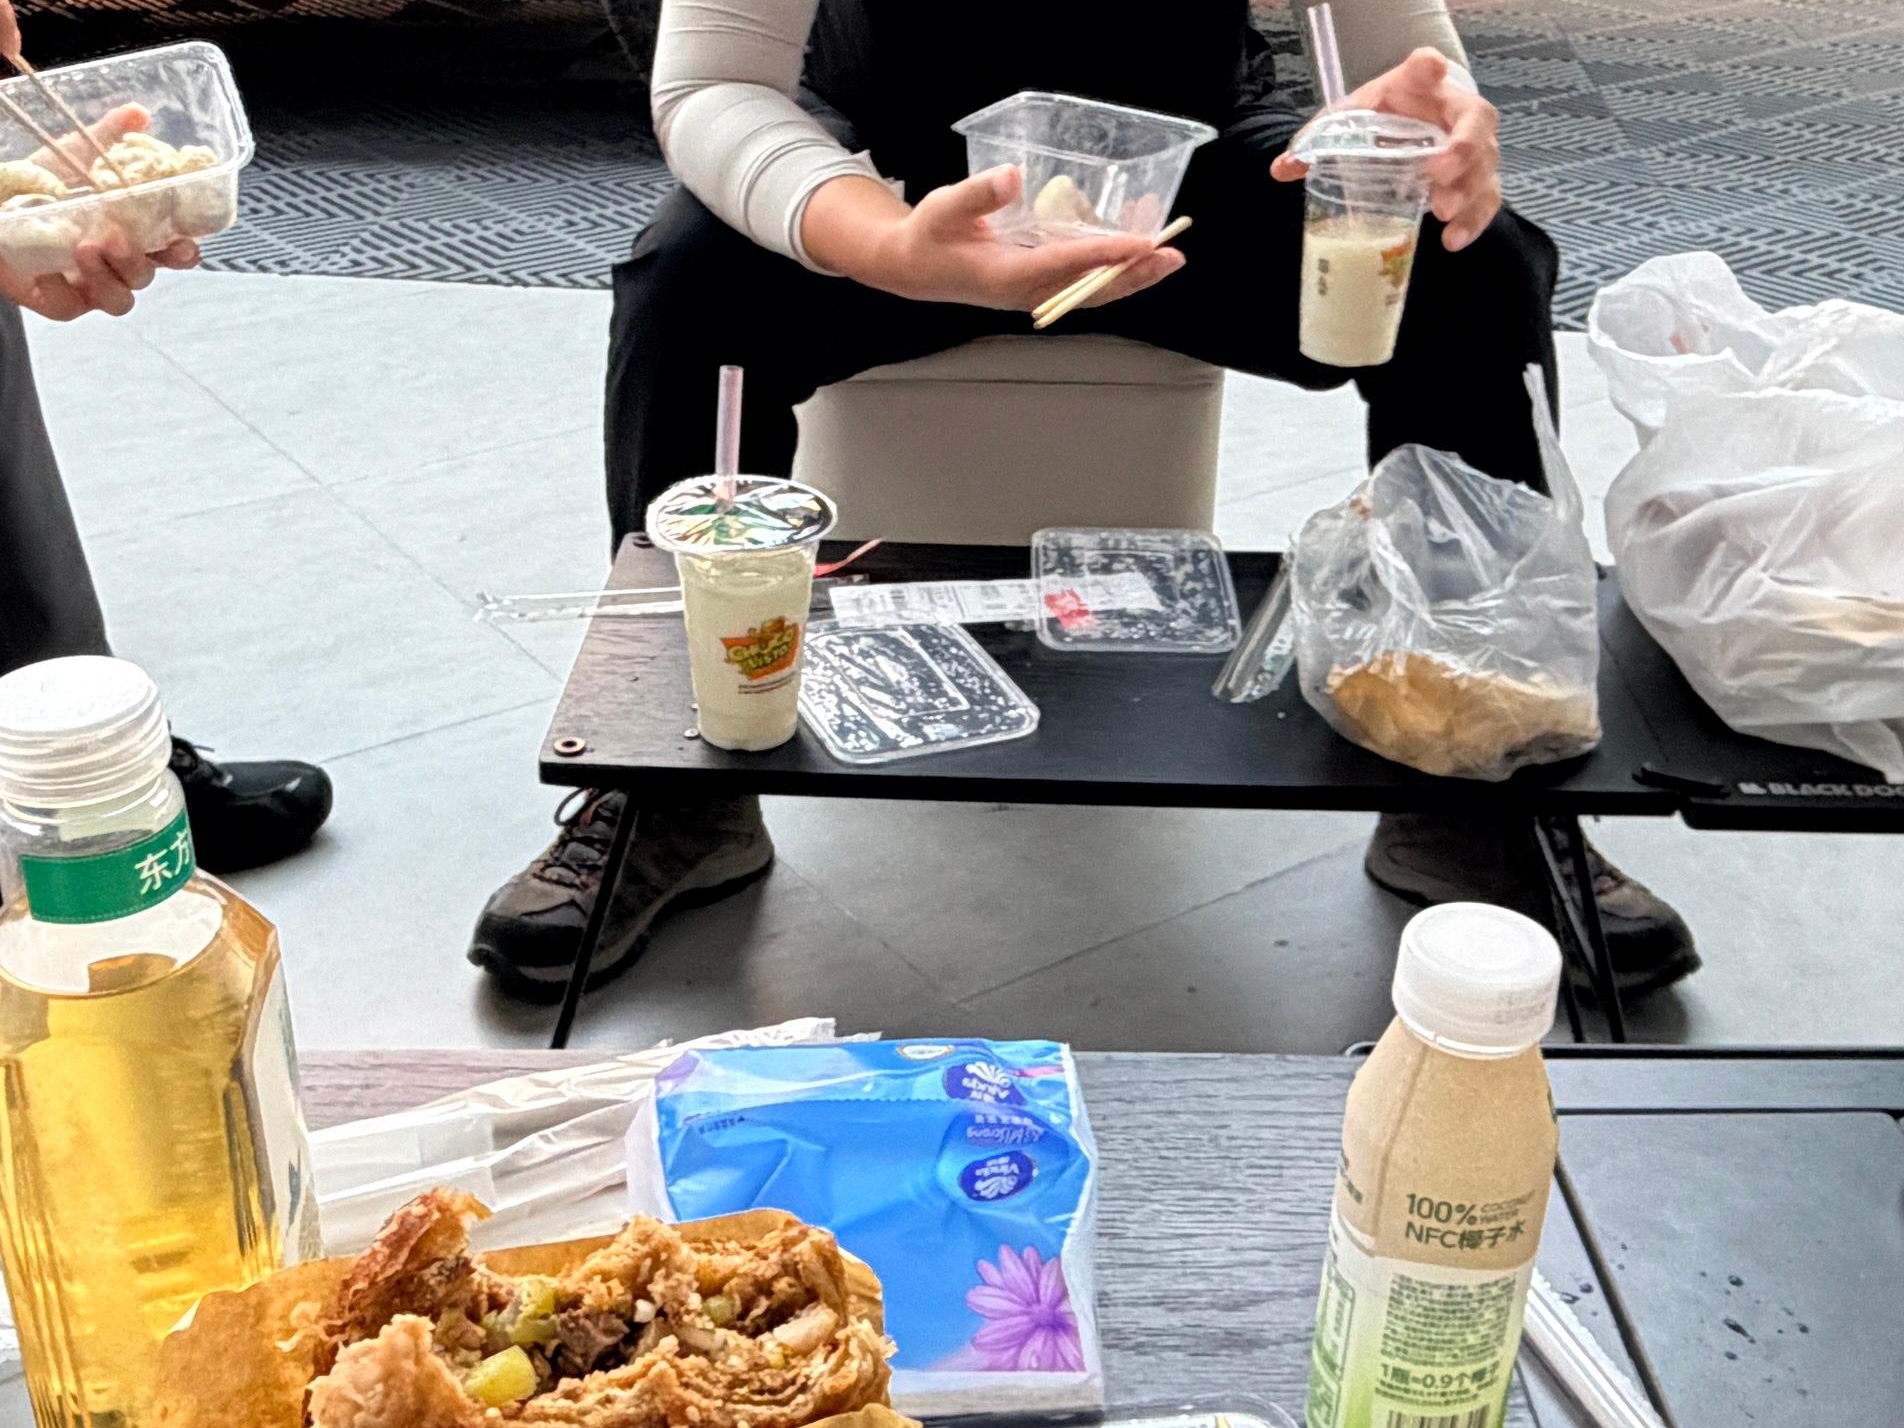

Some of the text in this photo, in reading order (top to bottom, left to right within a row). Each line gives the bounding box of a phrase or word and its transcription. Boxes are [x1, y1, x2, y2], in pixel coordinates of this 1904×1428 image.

[1768, 783, 1853, 797] BLACK
[1406, 1193, 1476, 1225] 100%
[1405, 1220, 1526, 1250] NFC椰子水
